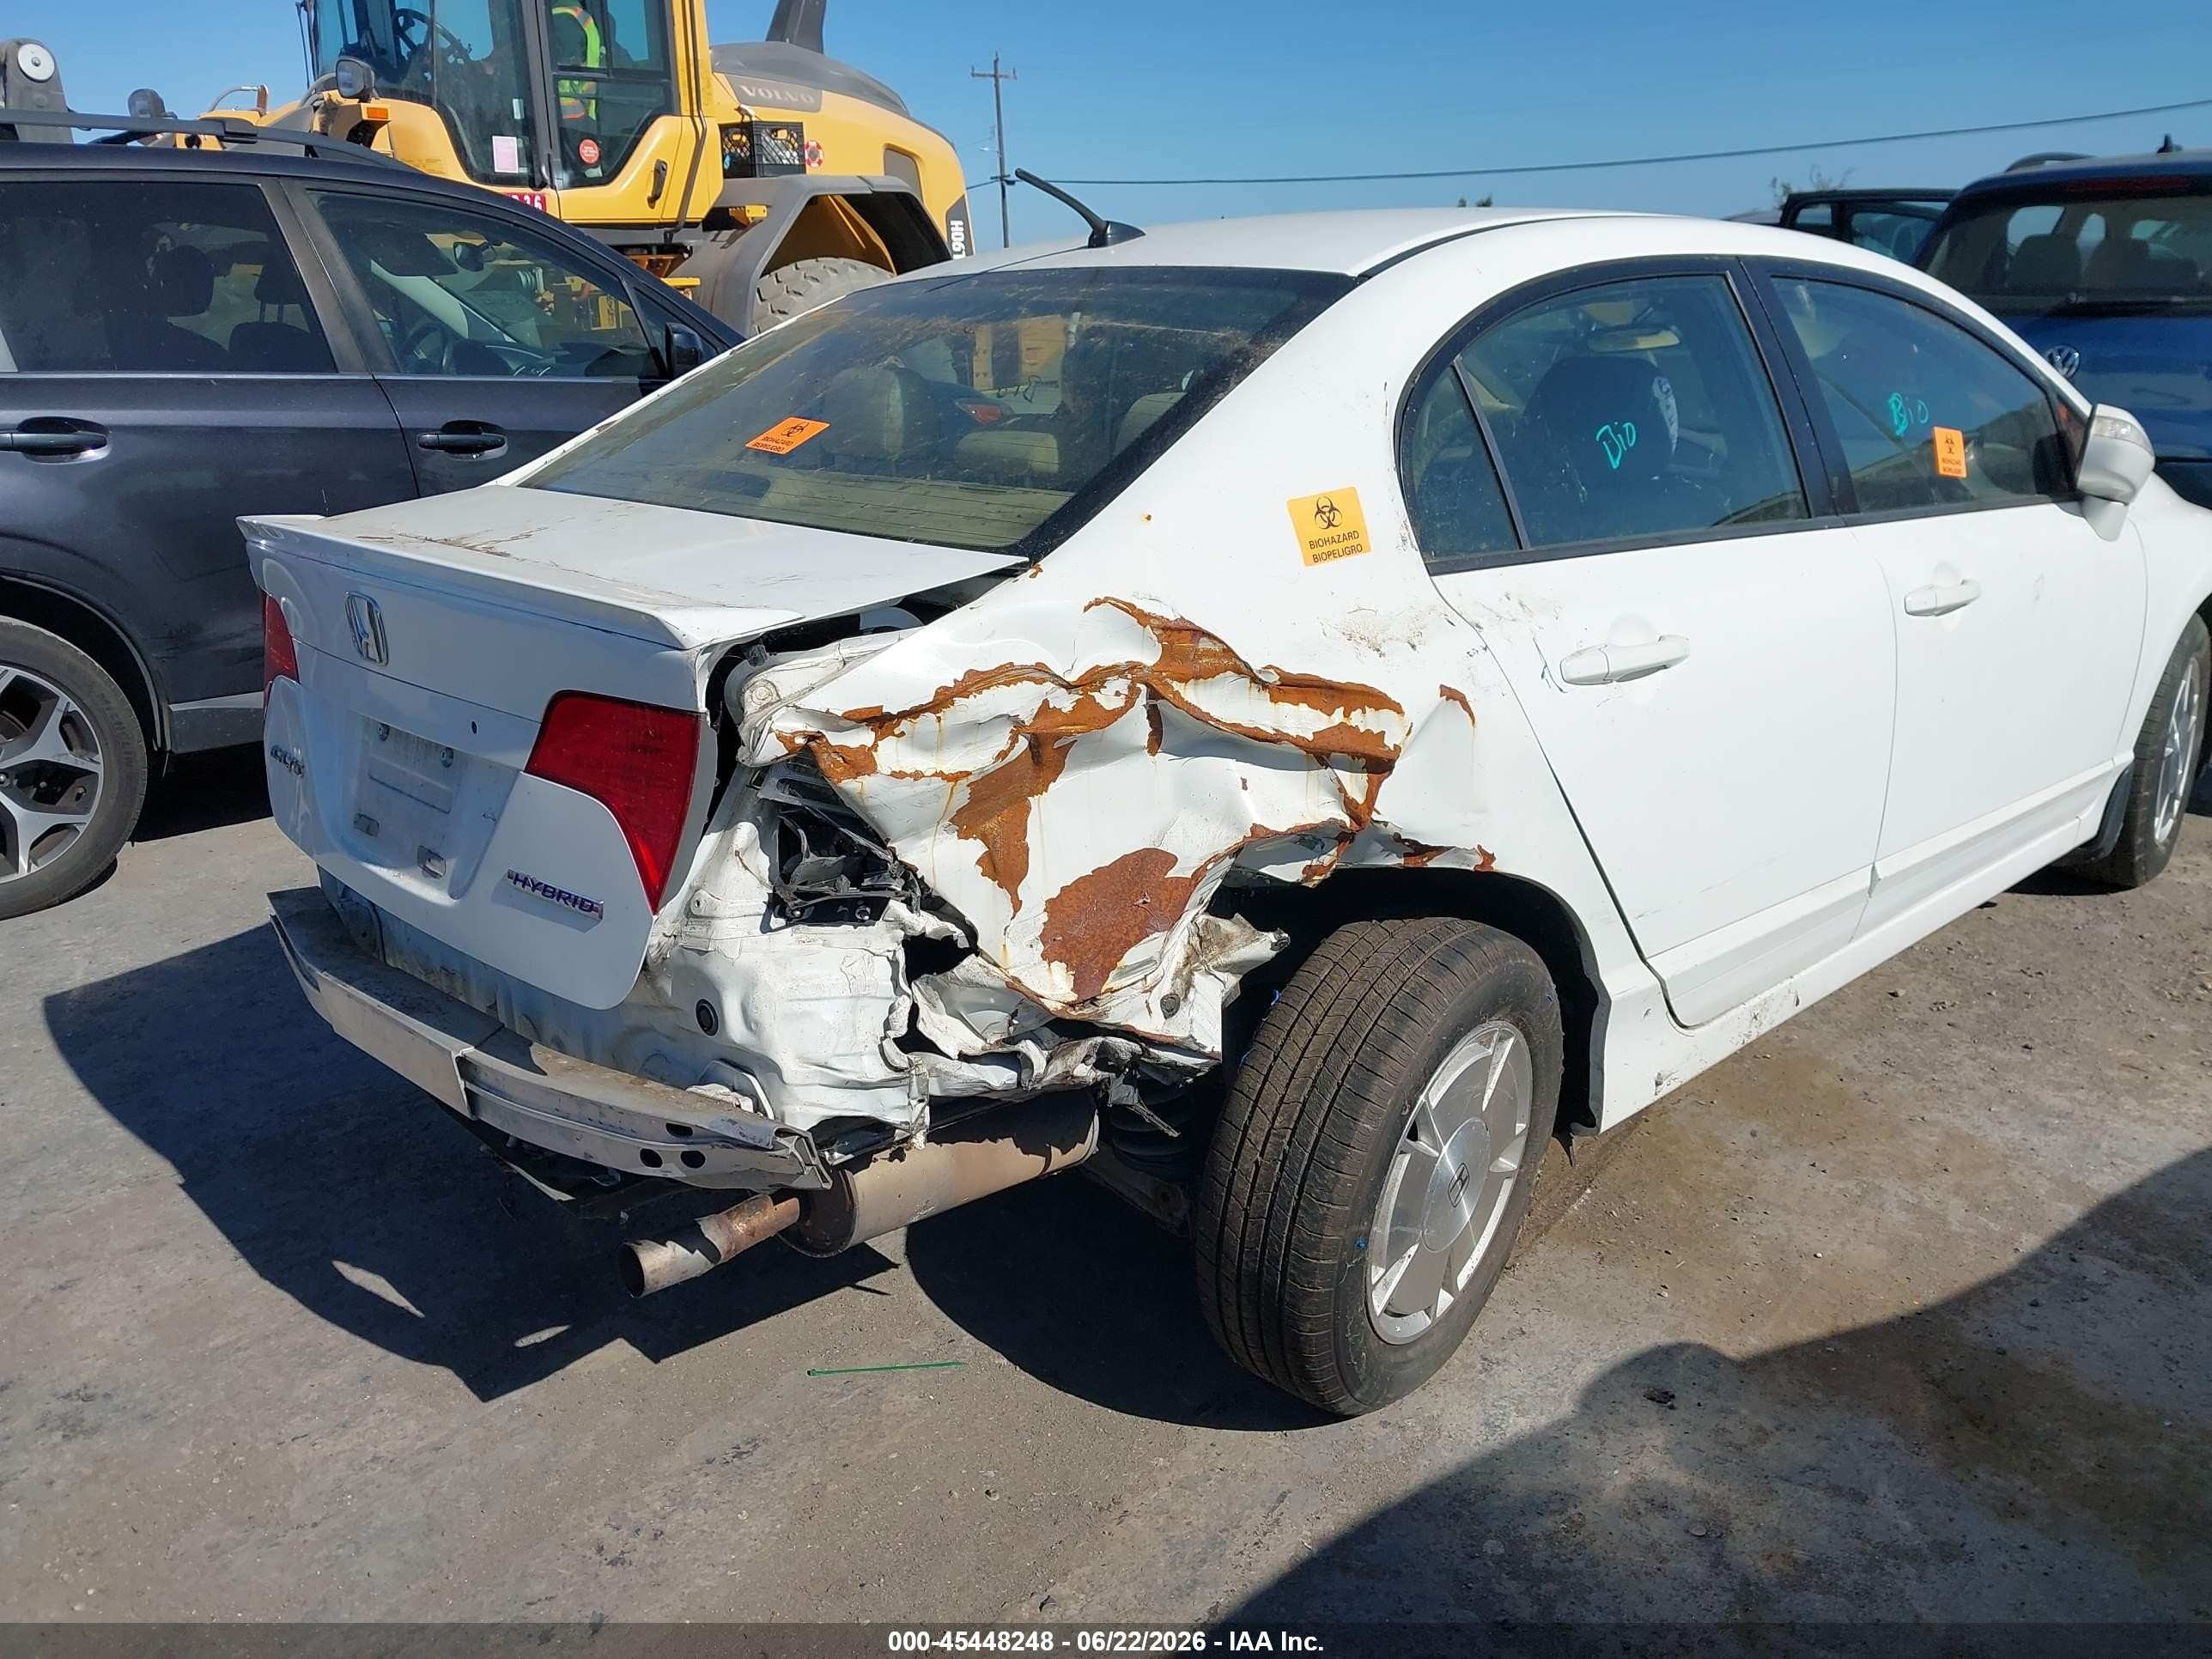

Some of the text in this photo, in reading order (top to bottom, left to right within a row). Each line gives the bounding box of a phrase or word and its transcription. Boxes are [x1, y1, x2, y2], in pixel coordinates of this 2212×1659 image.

[740, 85, 816, 103] VOLVO
[950, 220, 966, 259] L90H
[1308, 530, 1359, 550] BIOHAZARD
[1312, 543, 1363, 563] BIOPELIGRO
[513, 872, 595, 913] HYBRID
